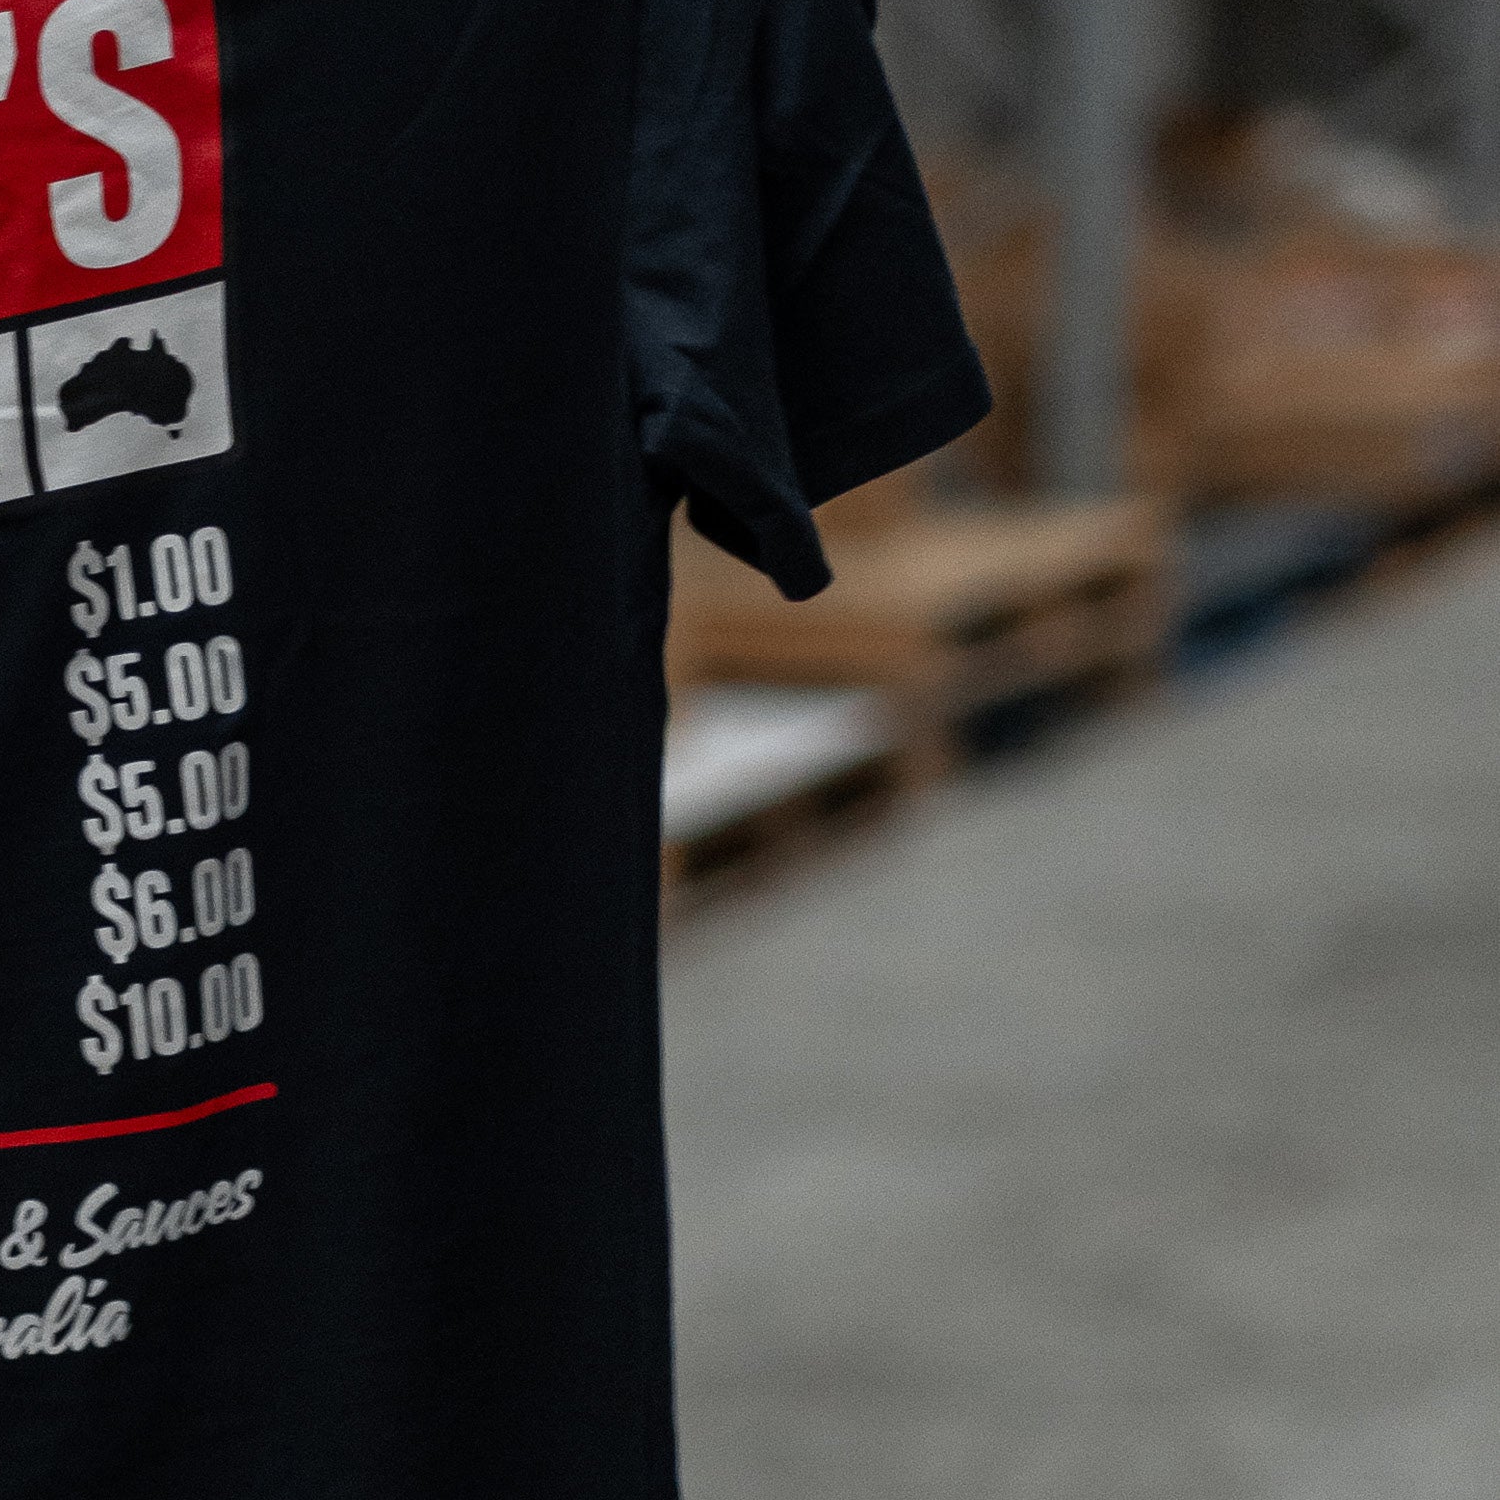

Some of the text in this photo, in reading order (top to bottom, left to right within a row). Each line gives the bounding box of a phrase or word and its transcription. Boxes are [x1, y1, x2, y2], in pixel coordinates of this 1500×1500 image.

[67, 527, 234, 638] $1.00
[65, 635, 247, 746] $5.00
[78, 741, 251, 855] $5.00
[90, 848, 258, 964] $6.00
[77, 953, 263, 1075] $10.00
[59, 1169, 262, 1268] Sauces
